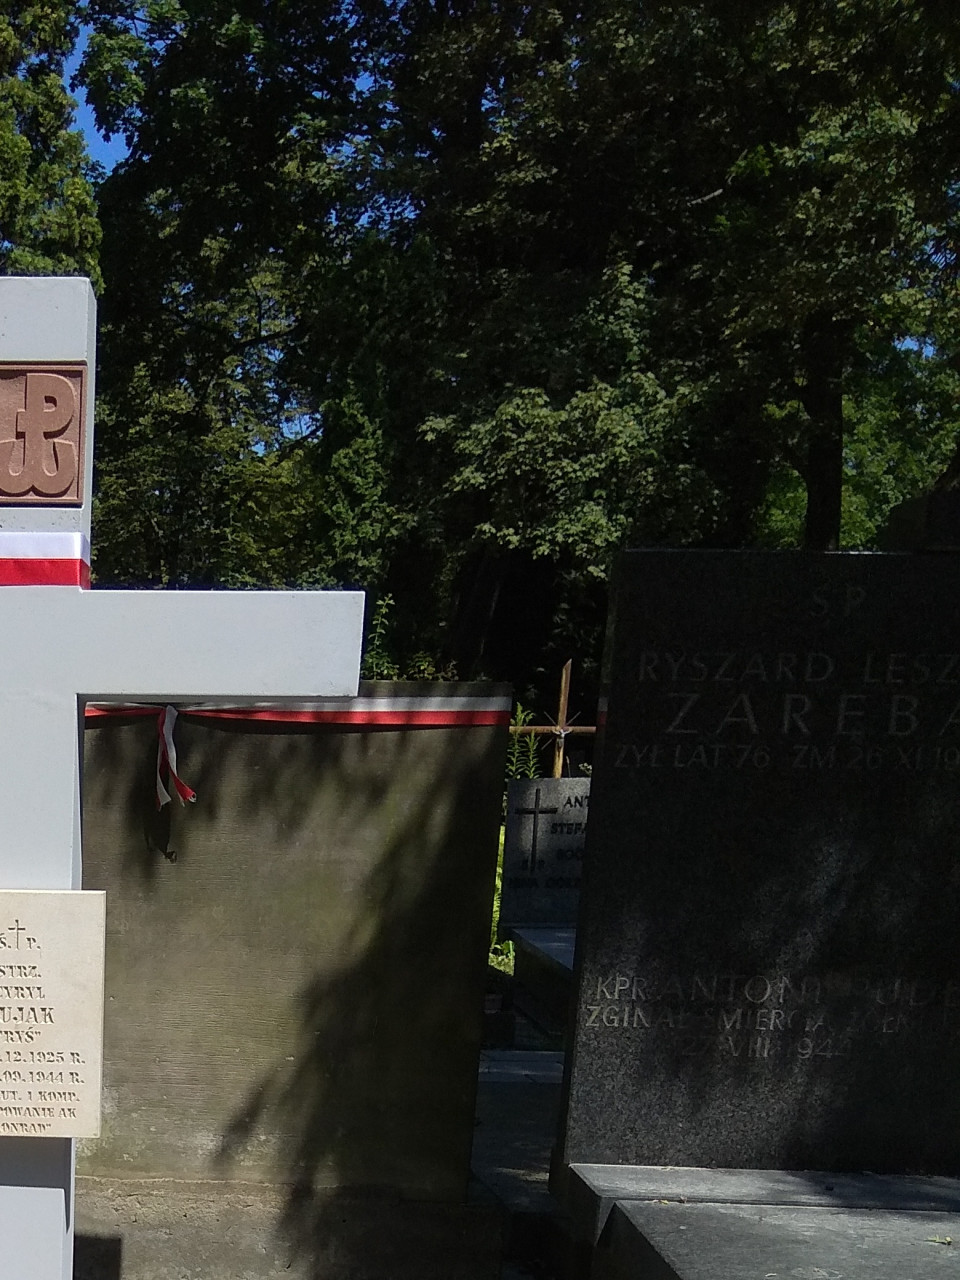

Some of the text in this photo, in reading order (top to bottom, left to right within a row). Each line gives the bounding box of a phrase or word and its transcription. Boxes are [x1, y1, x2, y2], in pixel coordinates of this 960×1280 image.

[638, 652, 835, 683] RYSZARD
[673, 744, 726, 769] LAT
[26, 937, 41, 950] P.
[69, 1051, 86, 1064] R.
[68, 1071, 85, 1085] R.
[38, 1091, 80, 1102] KOMP.
[58, 1107, 77, 1119] AK
